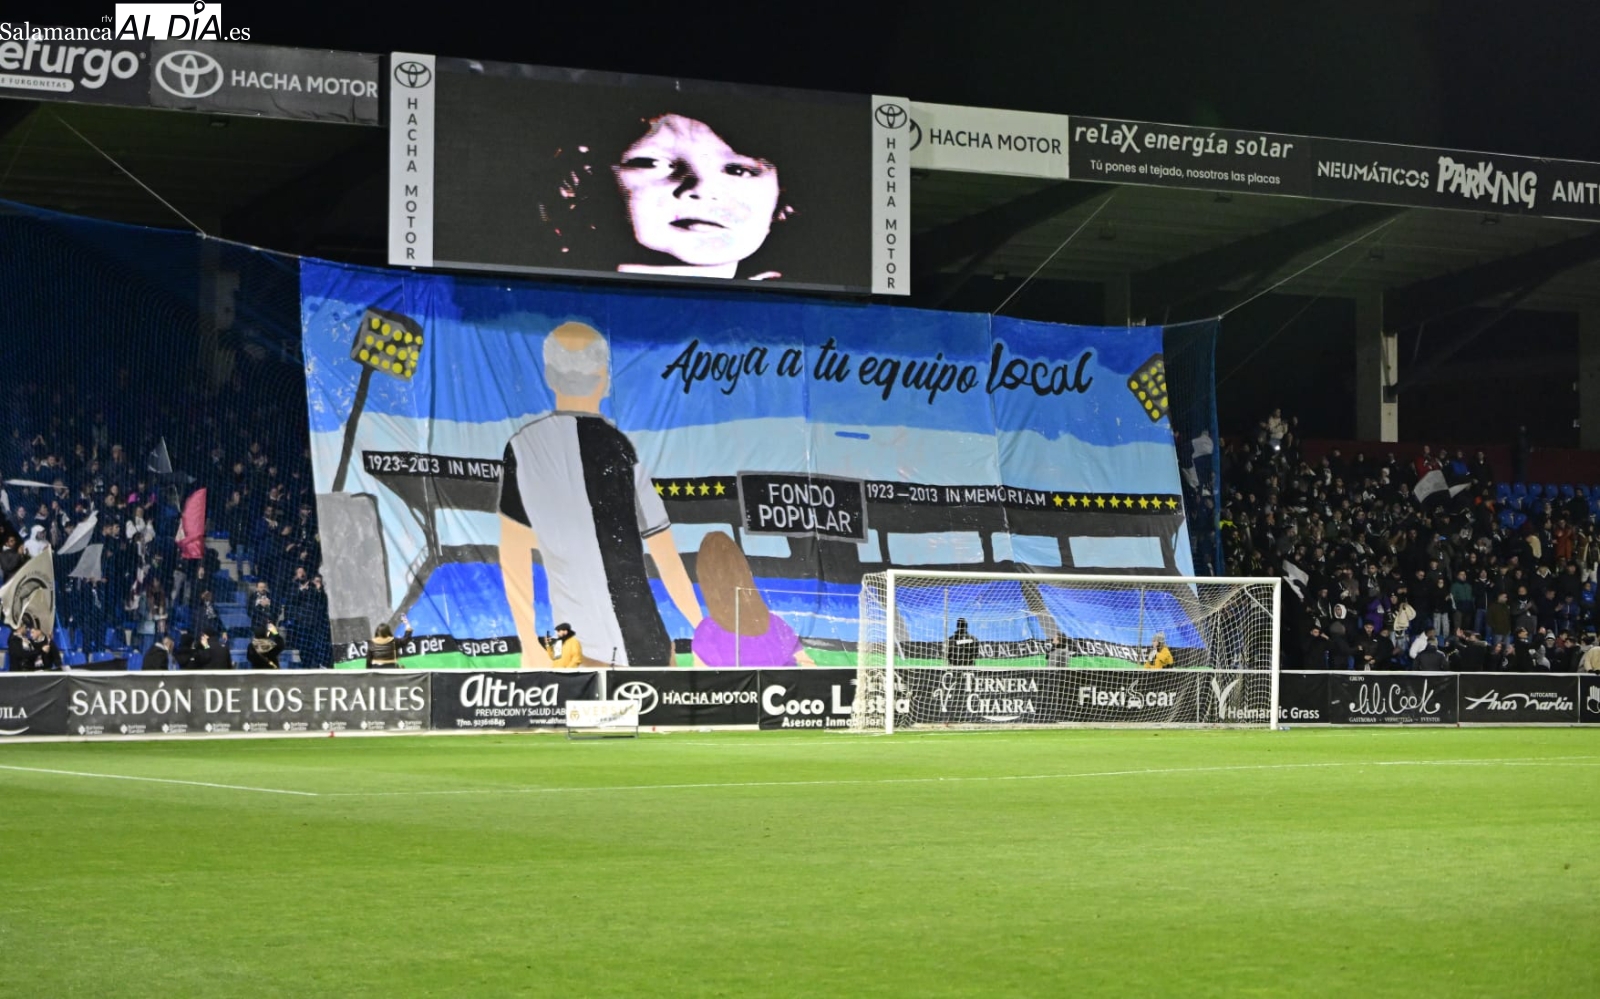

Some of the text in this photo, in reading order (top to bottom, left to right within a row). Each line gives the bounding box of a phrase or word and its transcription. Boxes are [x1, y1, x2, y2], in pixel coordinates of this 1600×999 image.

[9, 77, 67, 89] FURGONETAS
[231, 70, 378, 98] HACHA MOTOR
[929, 128, 1062, 155] HACHA MOTOR
[1144, 132, 1228, 157] energía
[1234, 137, 1294, 159] solar
[405, 97, 418, 260] HACHA MOTOR
[1090, 159, 1281, 187] Tú pones el tejado, nosotros las placas
[1317, 155, 1538, 209] NEUMÁTICOS PARKING
[1552, 179, 1600, 205] AMT
[885, 137, 897, 289] HACHA MOTOR
[661, 338, 769, 395] Apoya
[775, 348, 803, 378] a
[813, 336, 850, 382] tu
[858, 351, 979, 405] equipo
[448, 460, 464, 476] IN
[468, 463, 504, 479] MEM
[768, 483, 835, 508] FONDO
[945, 488, 960, 502] IN
[964, 486, 1047, 507] MEMORIAM
[759, 504, 852, 533] POPULAR
[421, 637, 446, 656] per
[458, 639, 508, 657] spera
[1077, 640, 1104, 655] LOS
[1104, 642, 1150, 663] VIERNE
[72, 681, 425, 716] SARDÓN DE LOS FRAILES
[663, 690, 758, 705] HACHA MOTOR
[762, 685, 825, 716] Coco
[475, 708, 520, 717] PREVENCION
[521, 708, 528, 716] Y
[782, 717, 823, 728] Asesora
[1227, 705, 1320, 719] Helmanic Grass
